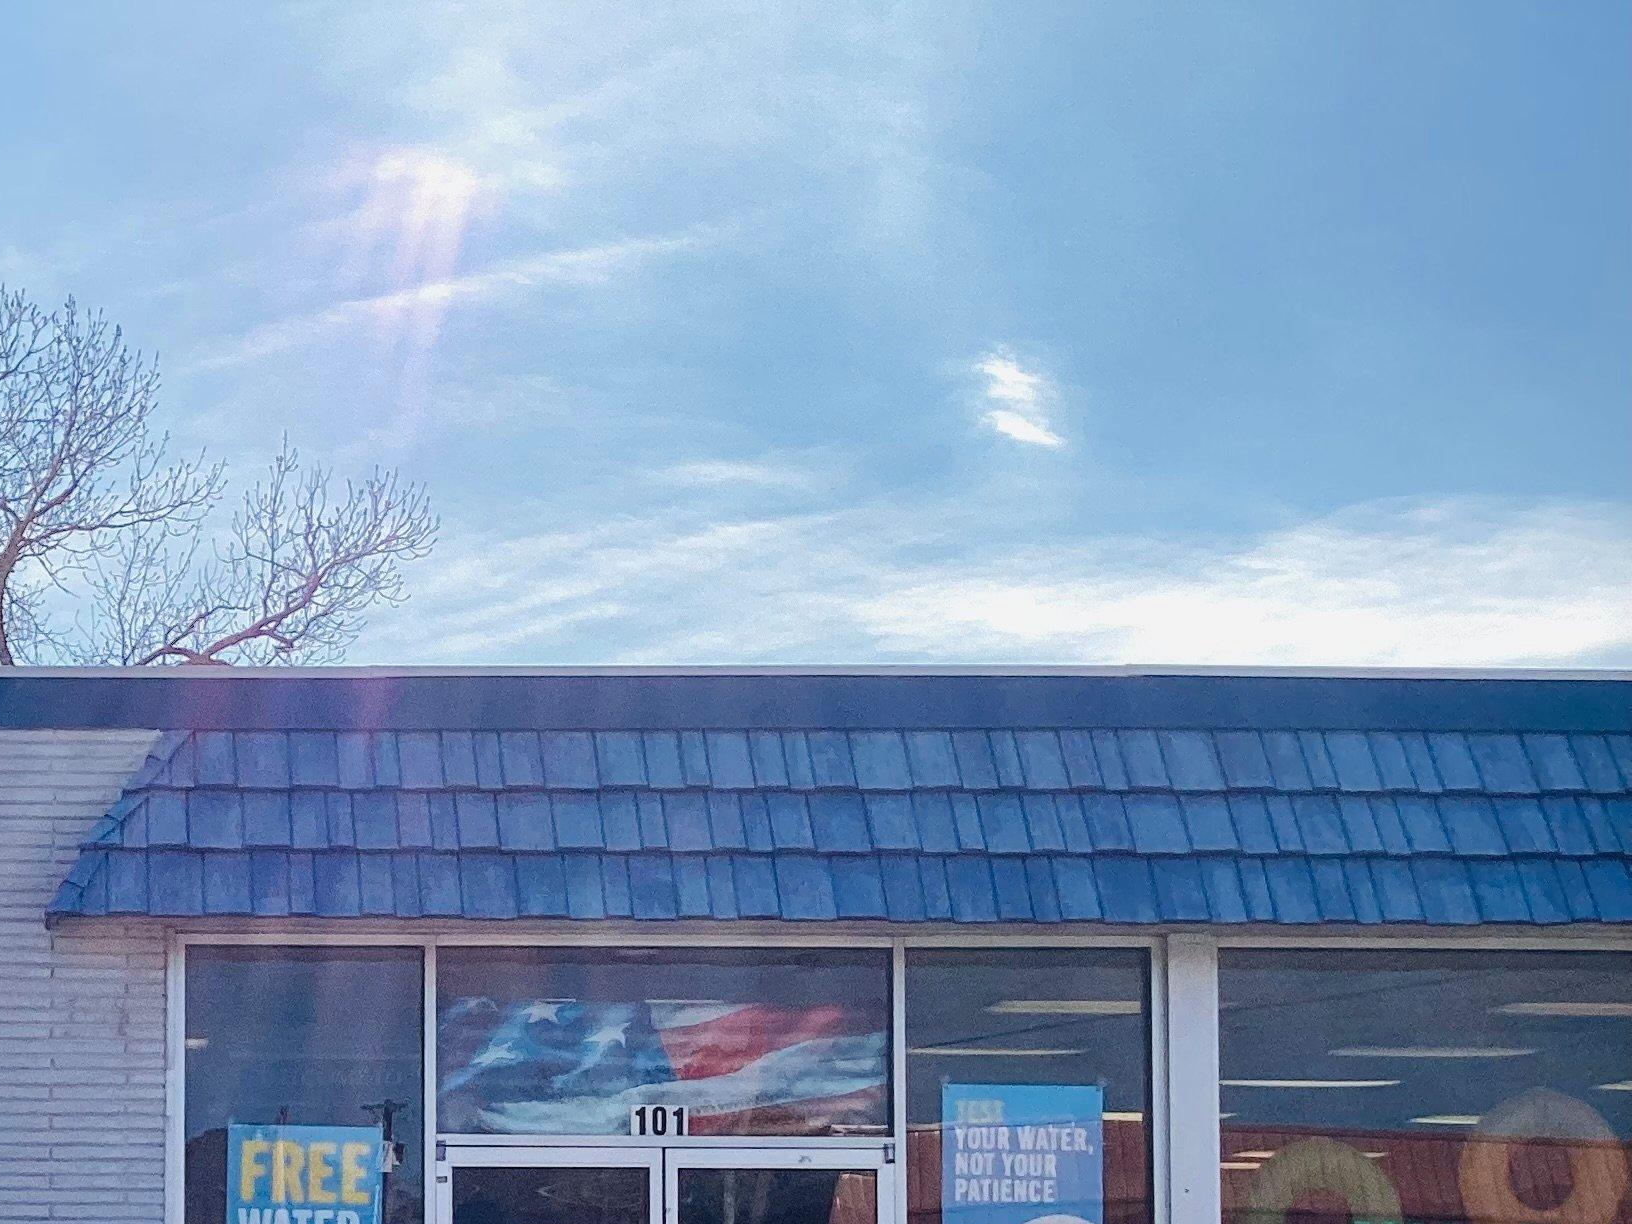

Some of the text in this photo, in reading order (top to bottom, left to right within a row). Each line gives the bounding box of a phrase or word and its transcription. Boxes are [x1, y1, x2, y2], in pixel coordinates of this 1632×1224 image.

[635, 1106, 684, 1136] 101
[955, 1126, 1094, 1155] YOUR WATER,
[239, 1140, 371, 1204] FREE
[955, 1152, 1057, 1178] NOT YOUR
[955, 1178, 1057, 1203] PATIENCE
